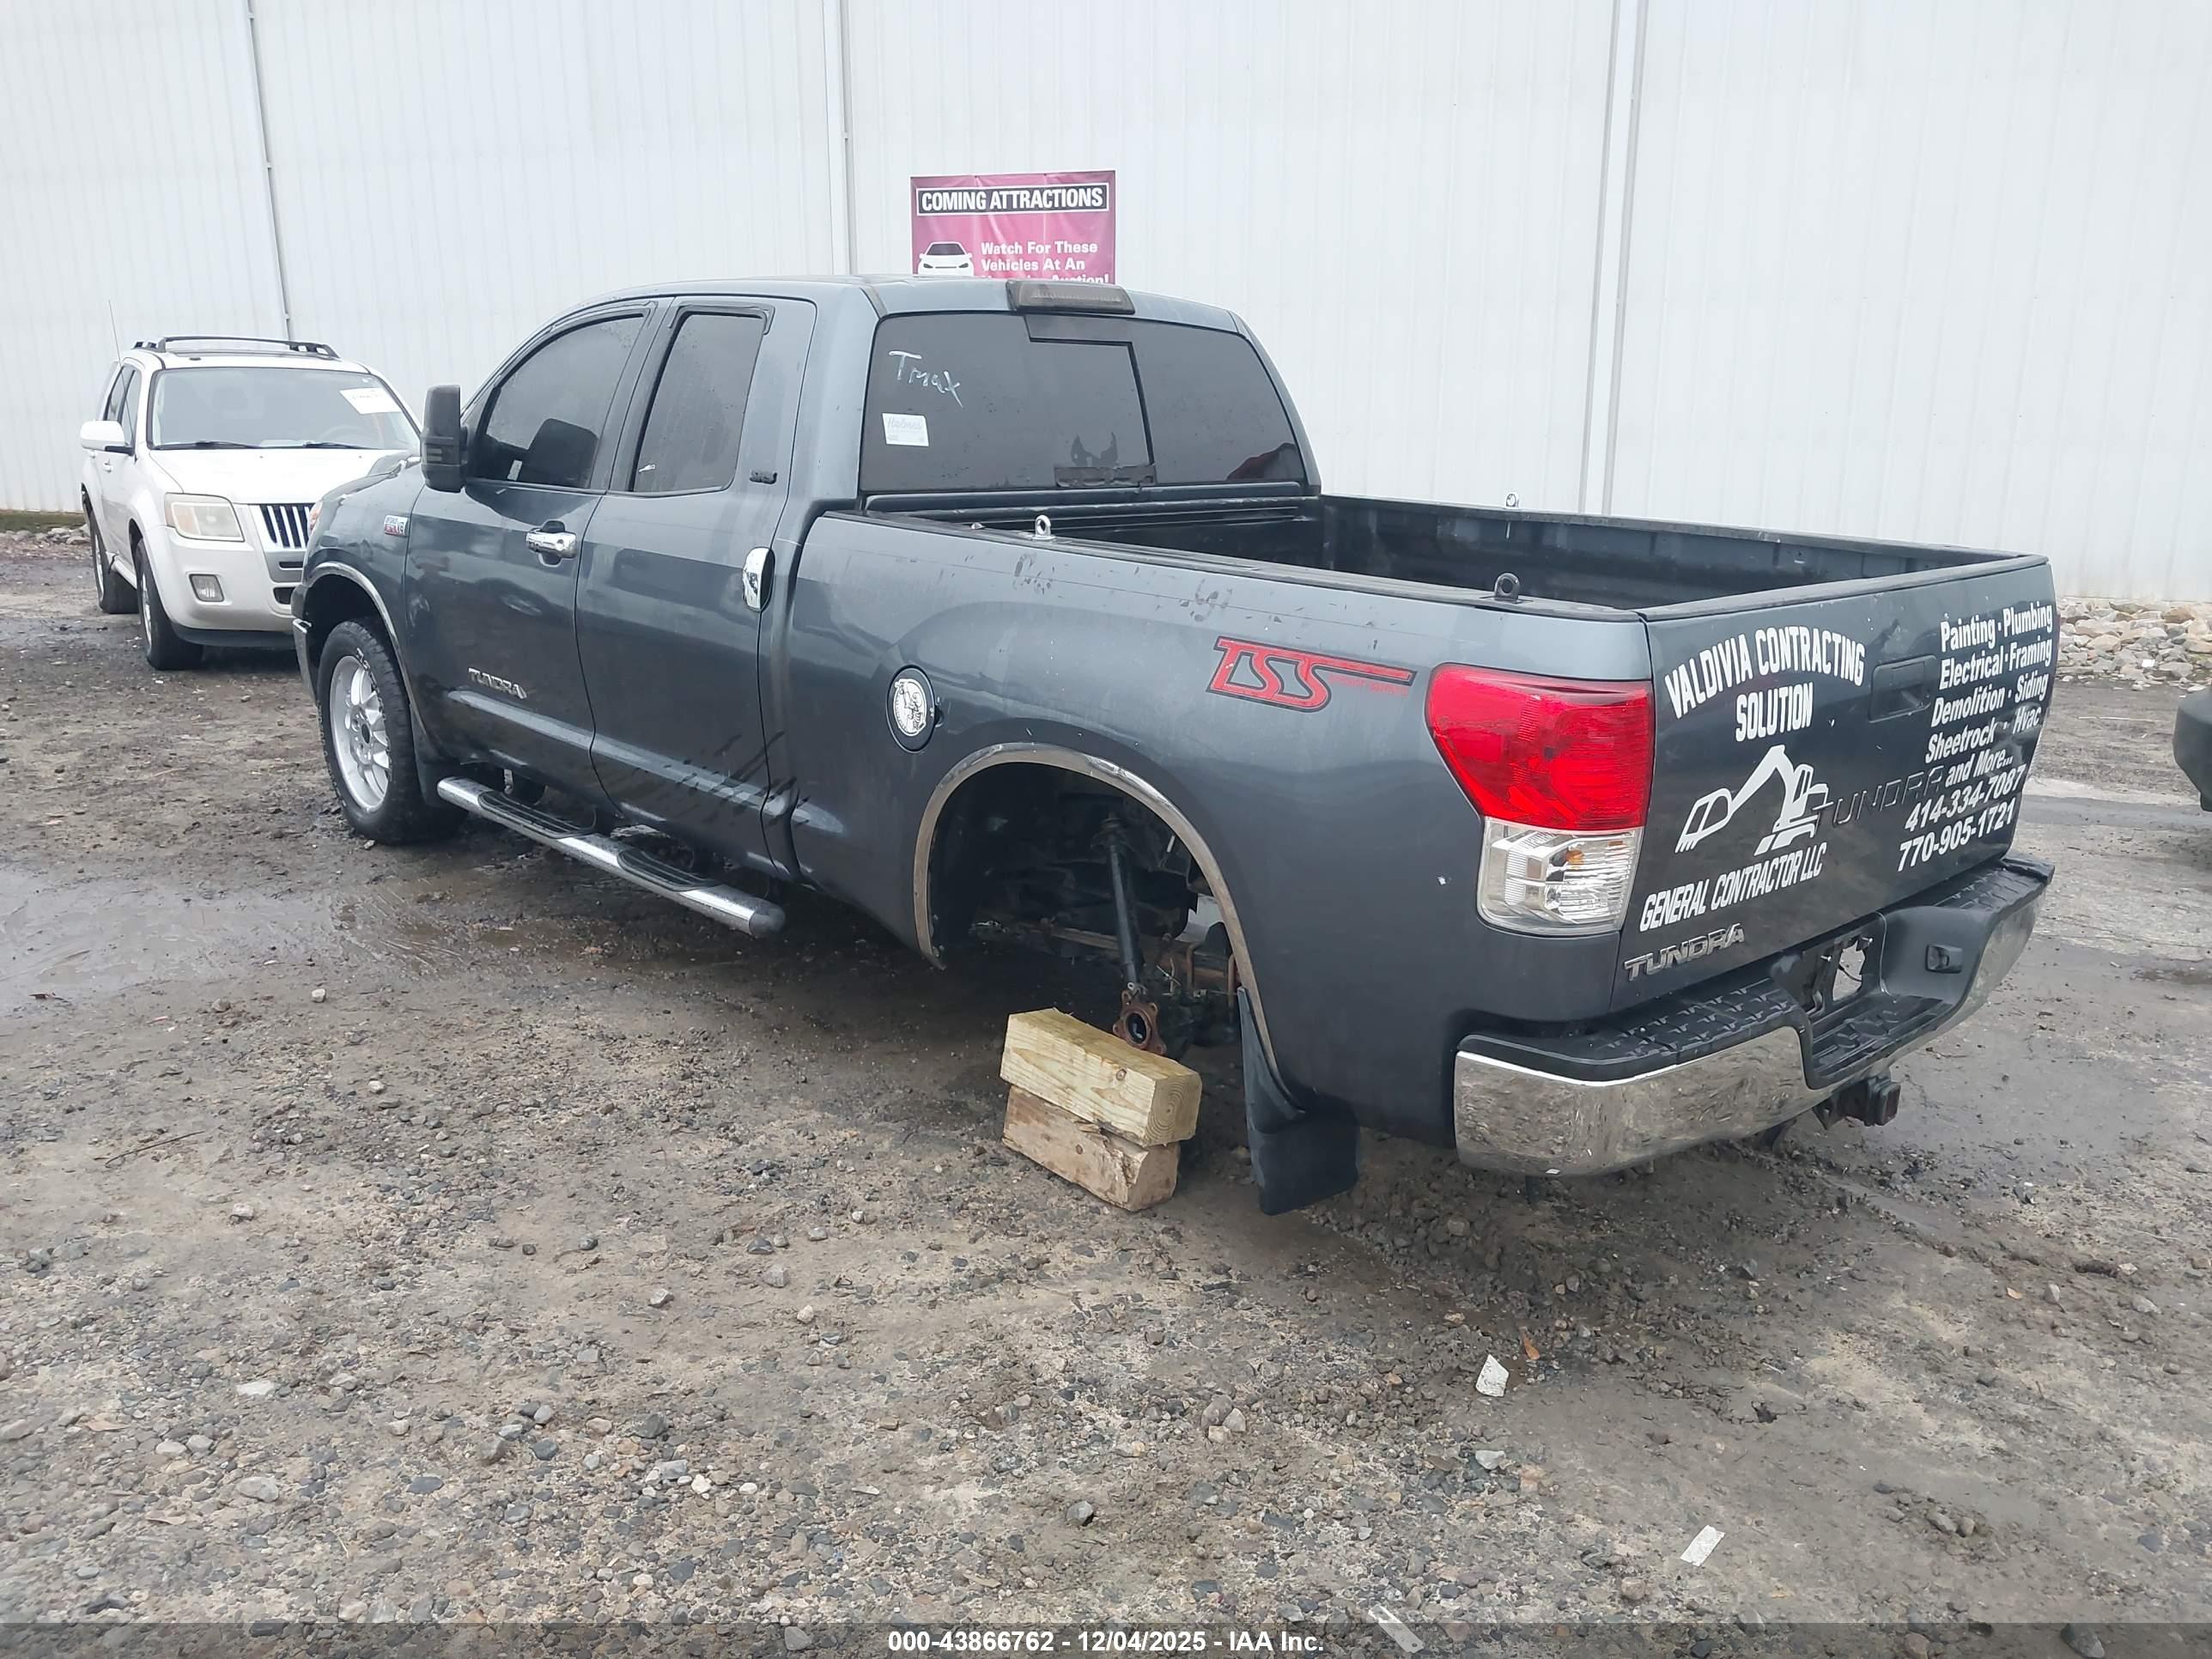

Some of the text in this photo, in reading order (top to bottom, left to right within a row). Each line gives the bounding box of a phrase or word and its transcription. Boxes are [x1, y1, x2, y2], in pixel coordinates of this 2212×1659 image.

[921, 187, 1103, 211] COMING ATTRACTIONS
[981, 240, 1098, 255] Watch For These
[981, 258, 1085, 271] Vehicles At An
[1940, 601, 2053, 653] Painting Plumbing
[1664, 626, 1865, 720] VALDIVIA CONTRACTING
[1938, 635, 2052, 690] Electrical Framing
[1735, 682, 1814, 742] SOLUTION
[1930, 670, 2050, 728] Demolition Siding
[1925, 705, 2042, 764] Sheetrock Hvac
[1945, 748, 2014, 788] and More...
[1904, 763, 2027, 832] 414-334-7087
[1897, 797, 2016, 872] 770-905-1721
[1639, 842, 1827, 933] GENERAL CONTRACTOR LLC
[1624, 922, 1746, 981] TUNDRA
